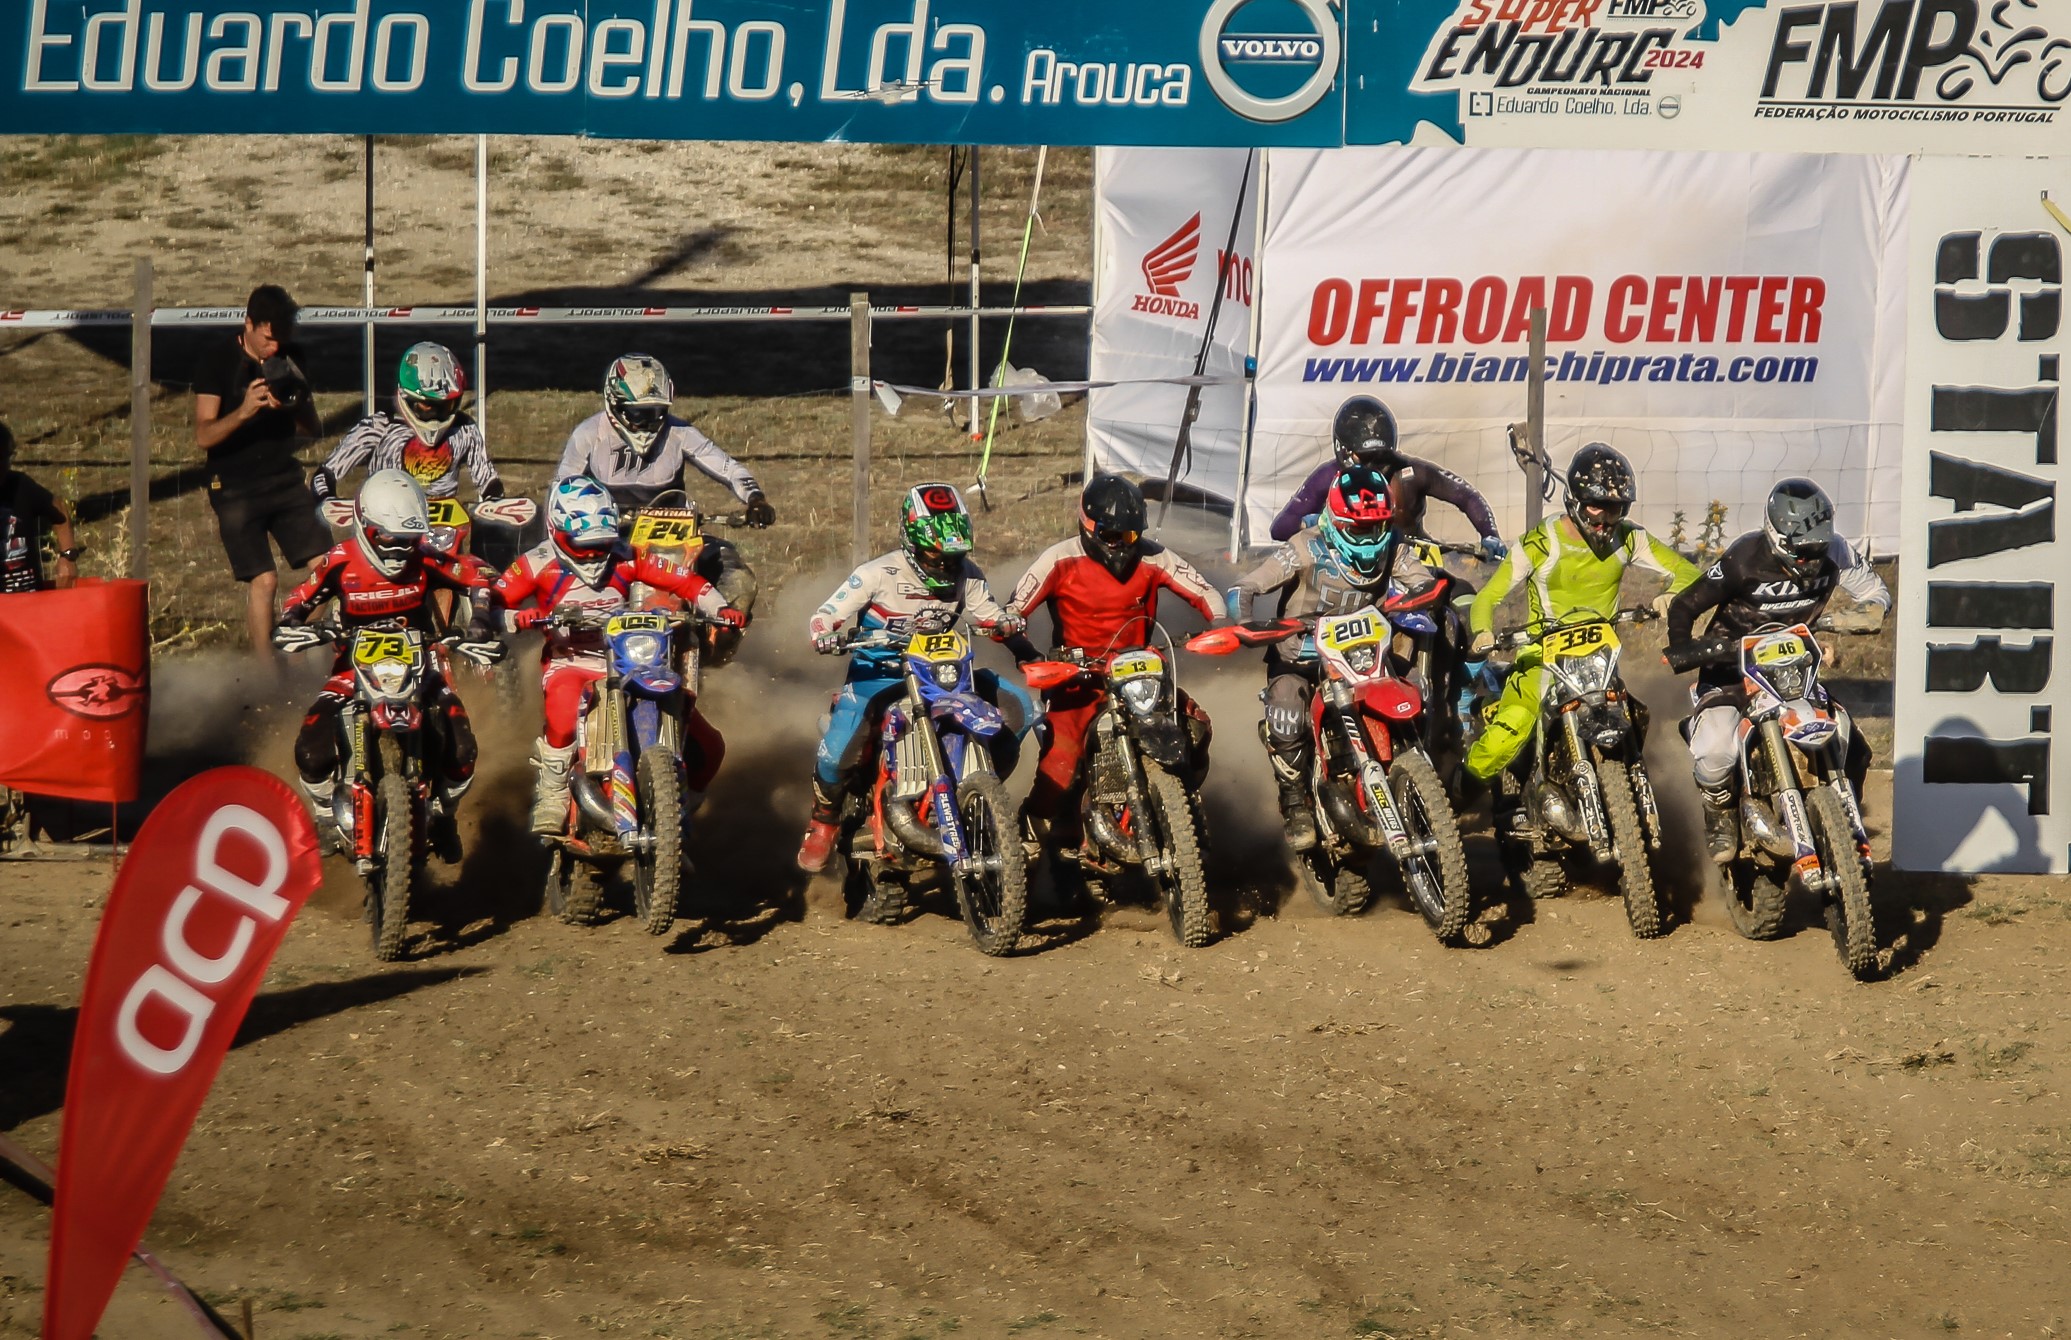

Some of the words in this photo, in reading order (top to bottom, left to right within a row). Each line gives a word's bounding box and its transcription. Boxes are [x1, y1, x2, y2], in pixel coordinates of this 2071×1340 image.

[23, 0, 431, 93] Eduardo
[1221, 39, 1320, 57] VOLVO
[1760, 0, 1980, 101] FMP
[1643, 49, 1706, 70] 2024
[1022, 48, 1193, 106] Arouca
[1526, 86, 1598, 96] CAMPEONATO
[1599, 88, 1652, 97] NACIONAL
[1496, 96, 1559, 115] Eduardo
[1622, 98, 1653, 117] Lda.
[1753, 105, 1850, 121] FEDERAÇÃO
[1852, 108, 1969, 122] MOTOCICLISMO
[1972, 111, 2054, 124] PORTUGAL
[1130, 293, 1200, 321] HONDA
[1306, 274, 1595, 347] OFFROAD
[1603, 273, 1827, 344] CENTER
[1301, 350, 1820, 385] www.bianchiprata.com
[647, 520, 692, 541] 24
[1922, 229, 2063, 817] START
[1334, 616, 1372, 643] 201
[1559, 625, 1603, 653] 336
[364, 635, 405, 659] 73
[924, 635, 956, 653] 83
[1777, 641, 1797, 656] 46
[1131, 660, 1148, 673] 13
[115, 802, 292, 1077] acp
